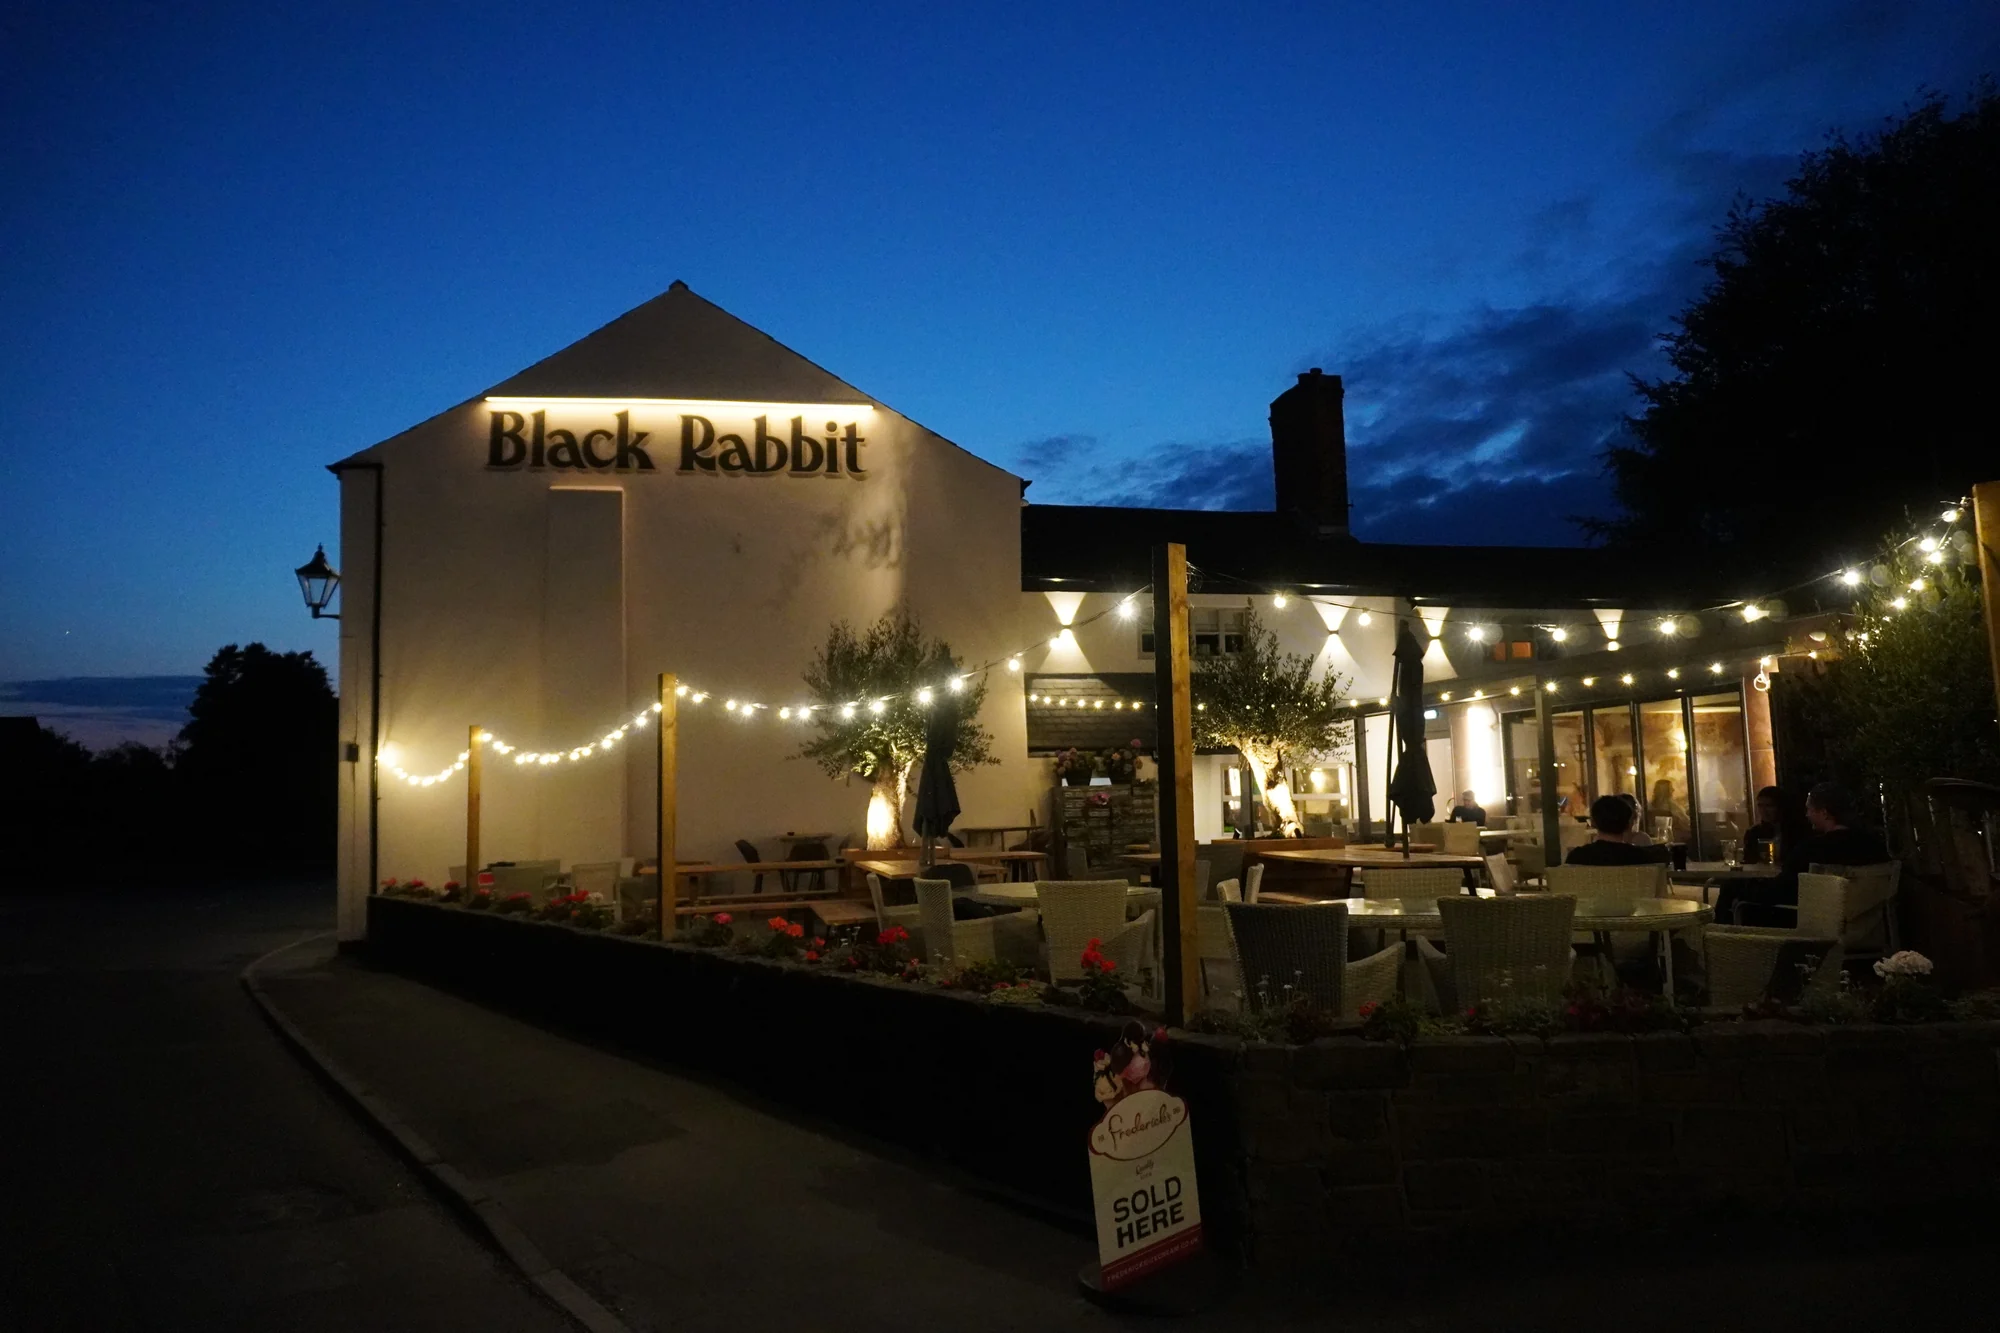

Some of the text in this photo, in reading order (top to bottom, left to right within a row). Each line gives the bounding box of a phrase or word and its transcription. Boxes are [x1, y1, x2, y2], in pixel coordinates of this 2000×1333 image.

[485, 409, 870, 479] Black Rabbit
[1113, 1176, 1181, 1223] SOLD
[1116, 1201, 1185, 1249] HERE
